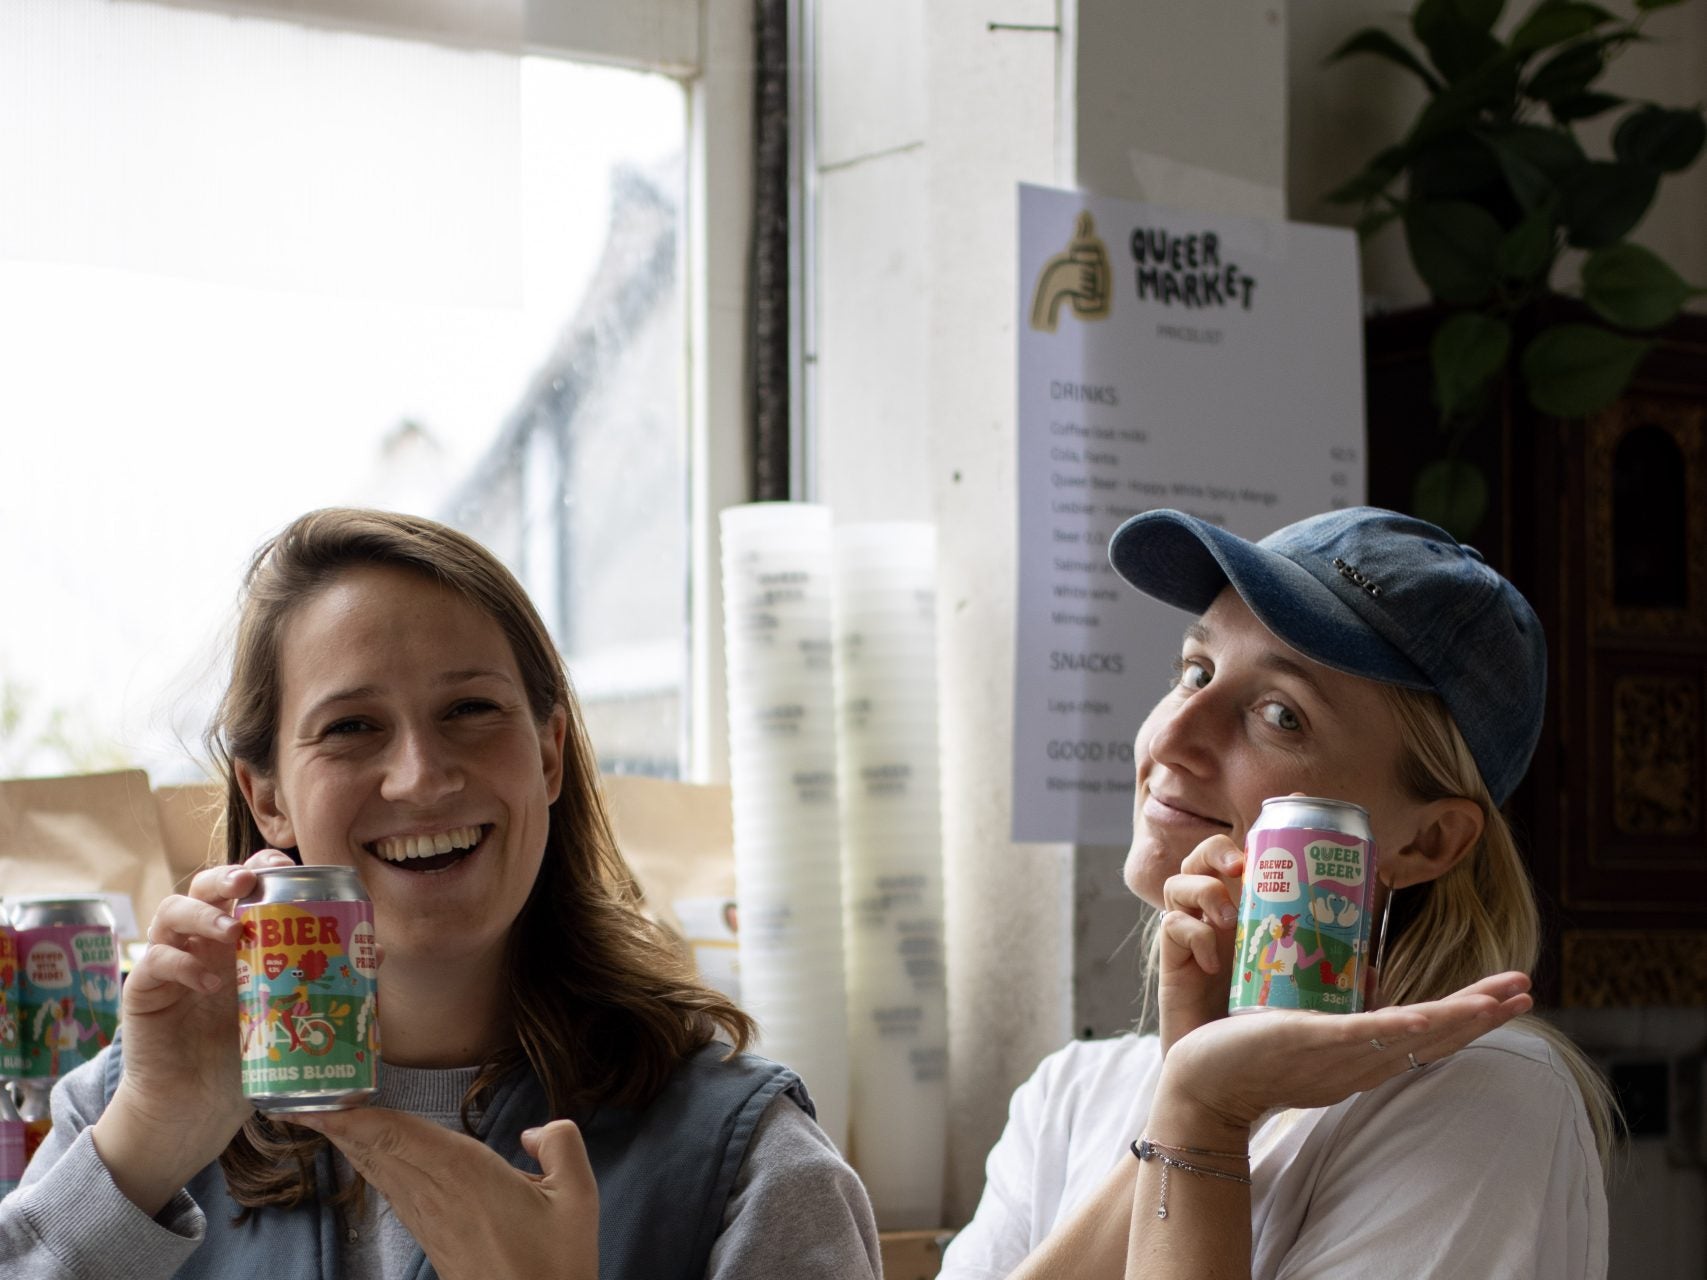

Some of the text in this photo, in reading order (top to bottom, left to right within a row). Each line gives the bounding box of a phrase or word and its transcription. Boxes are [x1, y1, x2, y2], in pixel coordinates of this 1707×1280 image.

[1130, 227, 1220, 271] QUEER
[1136, 264, 1257, 312] MARKET
[1050, 380, 1119, 406] DRINKS
[1049, 650, 1125, 674] SNACKS
[1046, 739, 1136, 763] GOOD FO
[1310, 846, 1360, 864] QUEER
[1259, 860, 1294, 870] BREWED
[1315, 863, 1354, 879] BEER
[1263, 872, 1284, 880] WITH
[1257, 882, 1291, 893] PRIDE!
[303, 1064, 357, 1080] BLOND
